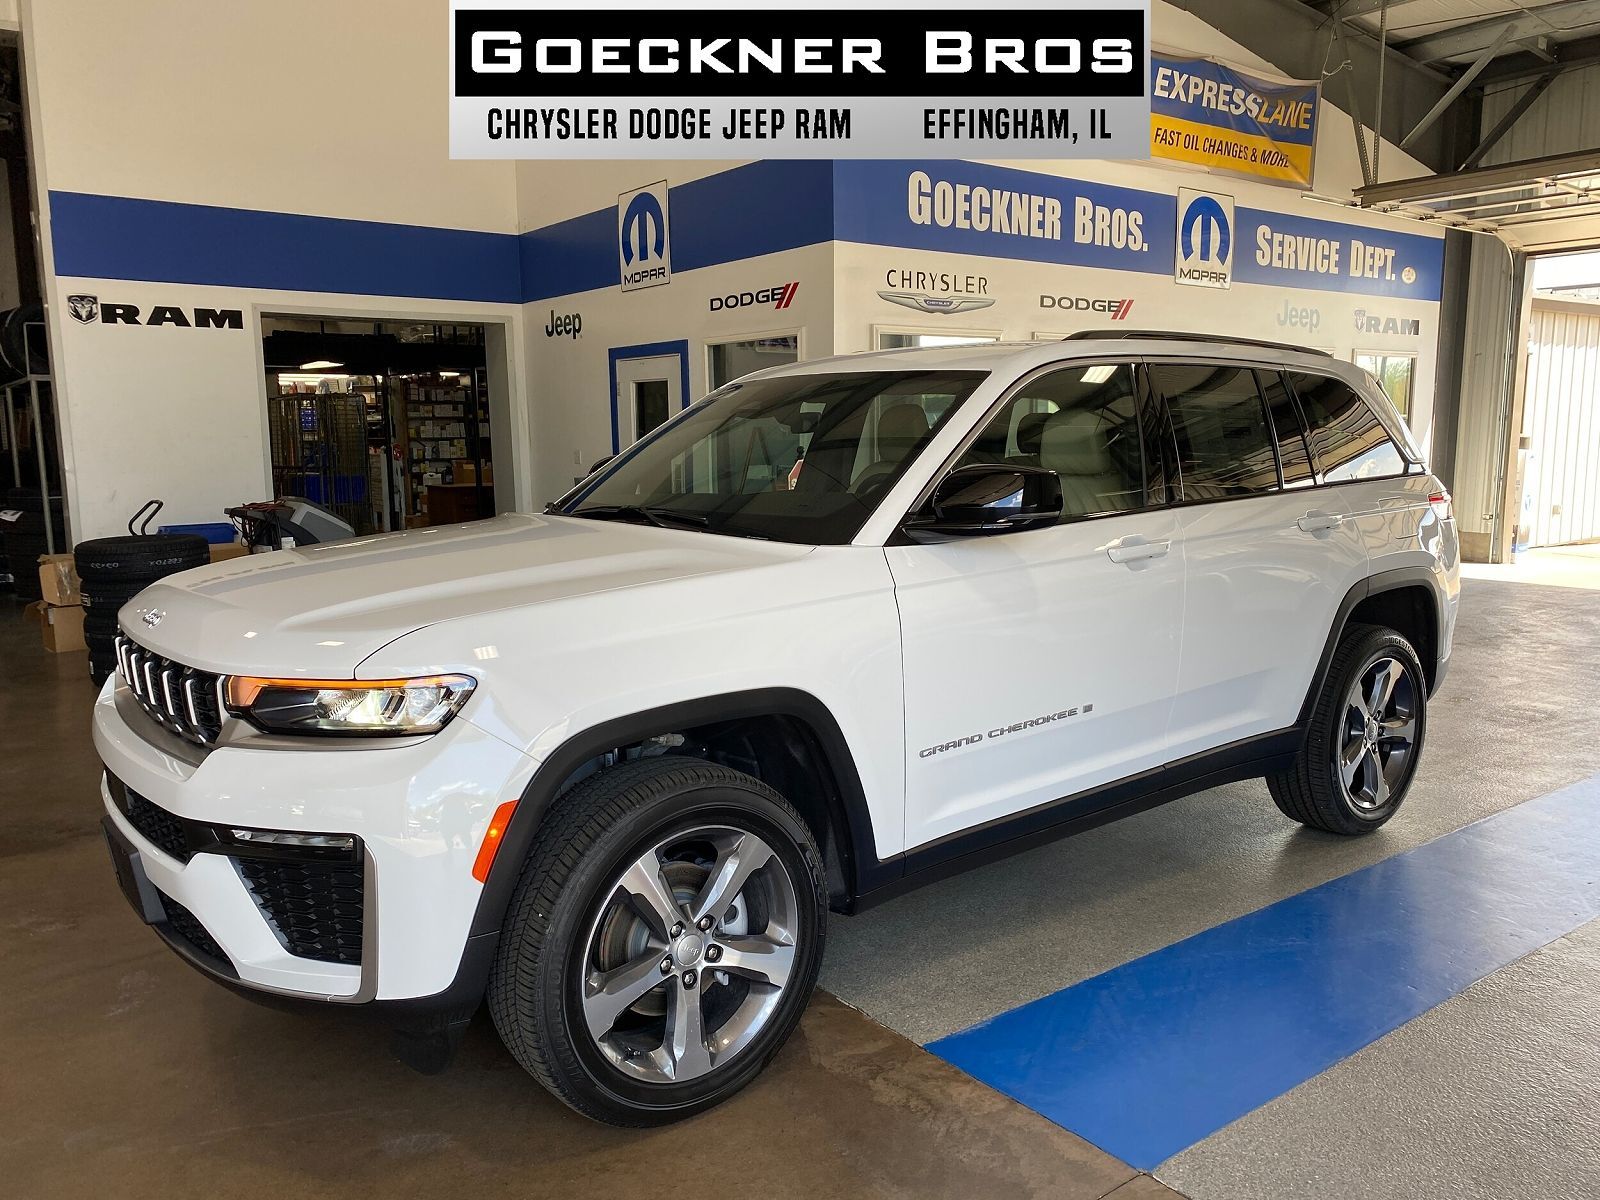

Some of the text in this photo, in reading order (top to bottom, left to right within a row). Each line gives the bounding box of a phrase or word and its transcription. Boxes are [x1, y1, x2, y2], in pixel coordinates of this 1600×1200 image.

[1153, 127, 1289, 168] FAST OIL CHANGES & MORE
[908, 170, 1149, 252] GOECKNER BROS.
[1255, 224, 1396, 281] SERVICE DEPT.
[623, 266, 666, 286] MOPAR
[886, 269, 988, 294] CHRYSLER
[1179, 267, 1228, 285] MOPAR
[710, 285, 785, 312] DODGE
[1039, 294, 1121, 313] DODGE
[100, 303, 244, 329] RAM
[545, 310, 582, 339] Jeep
[1276, 299, 1321, 333] Jeep
[1365, 315, 1420, 336] RAM
[919, 707, 1079, 758] GRAND CHEROKEE
